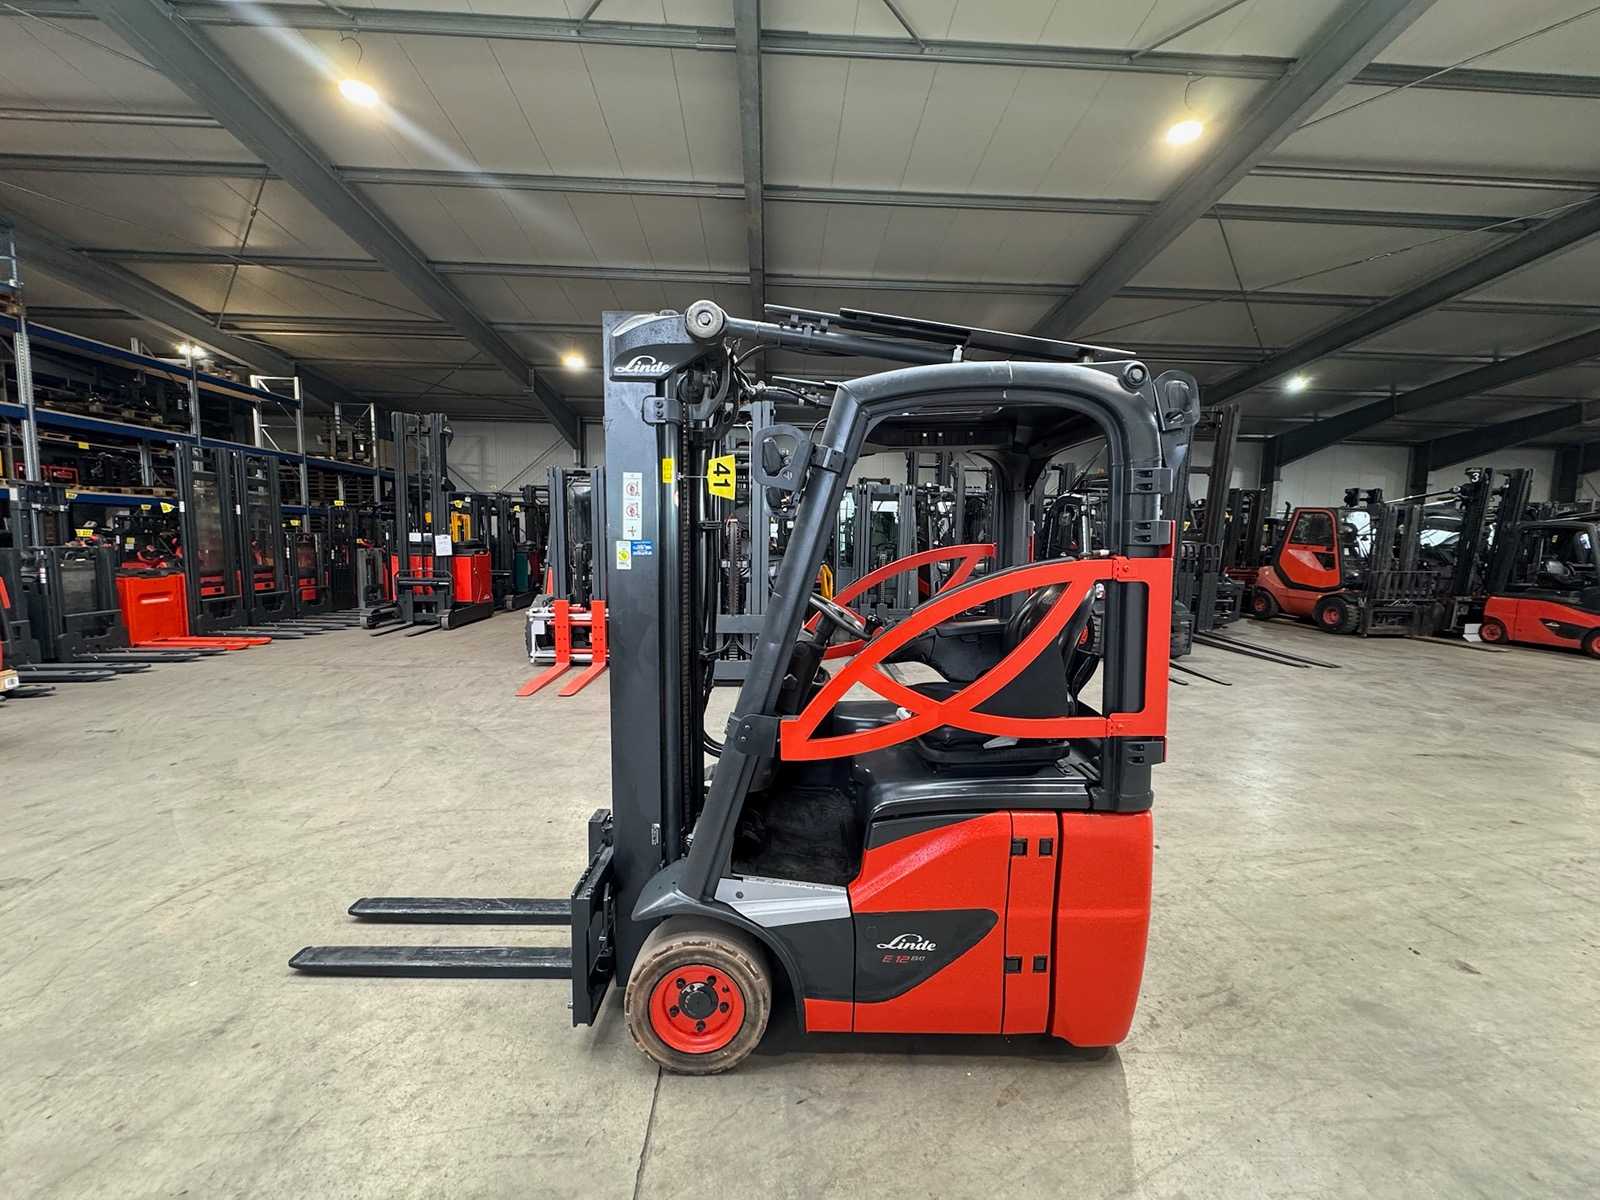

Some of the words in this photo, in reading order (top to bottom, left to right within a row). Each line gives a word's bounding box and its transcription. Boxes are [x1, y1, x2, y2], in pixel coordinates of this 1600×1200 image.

[614, 355, 671, 373] Linde
[713, 462, 731, 487] 41
[1471, 472, 1480, 483] 3
[876, 933, 937, 951] Linde
